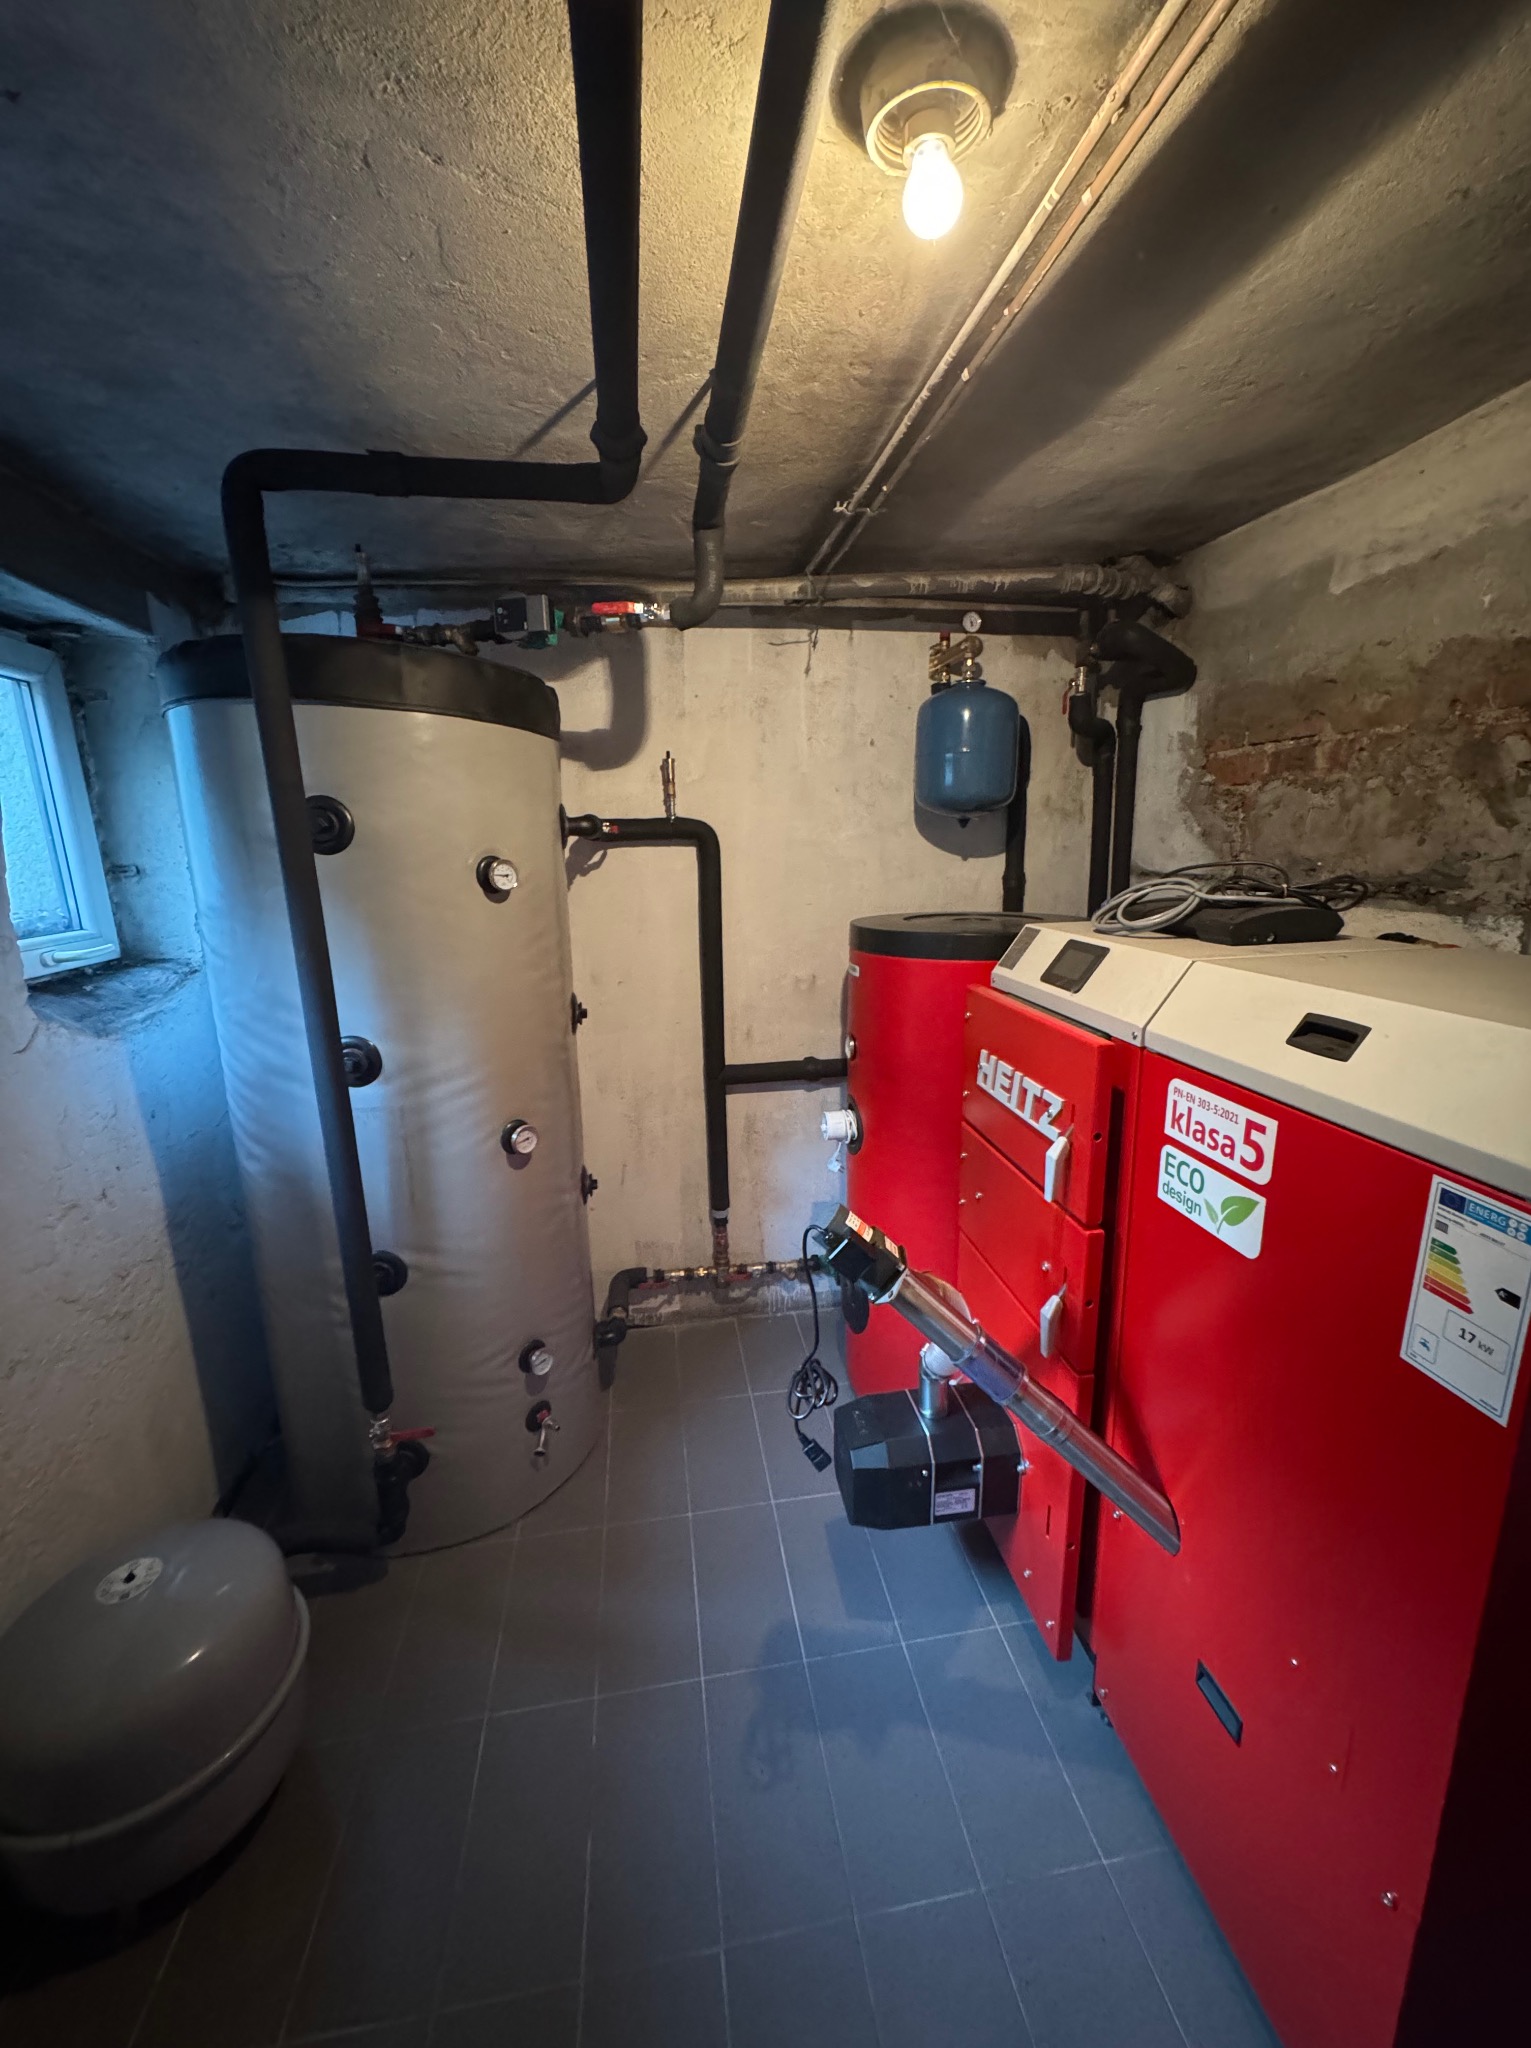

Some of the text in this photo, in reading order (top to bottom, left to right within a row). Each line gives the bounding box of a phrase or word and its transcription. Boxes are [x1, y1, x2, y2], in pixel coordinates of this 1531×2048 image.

[977, 1049, 1066, 1142] HEITZ
[1173, 1086, 1239, 1125] PN-EN 303-5:2021
[1170, 1100, 1267, 1172] klasa 5
[1164, 1151, 1205, 1194] ECO
[1162, 1180, 1202, 1217] design
[1468, 1202, 1507, 1226] ENERG
[1458, 1327, 1495, 1356] 17 kW
